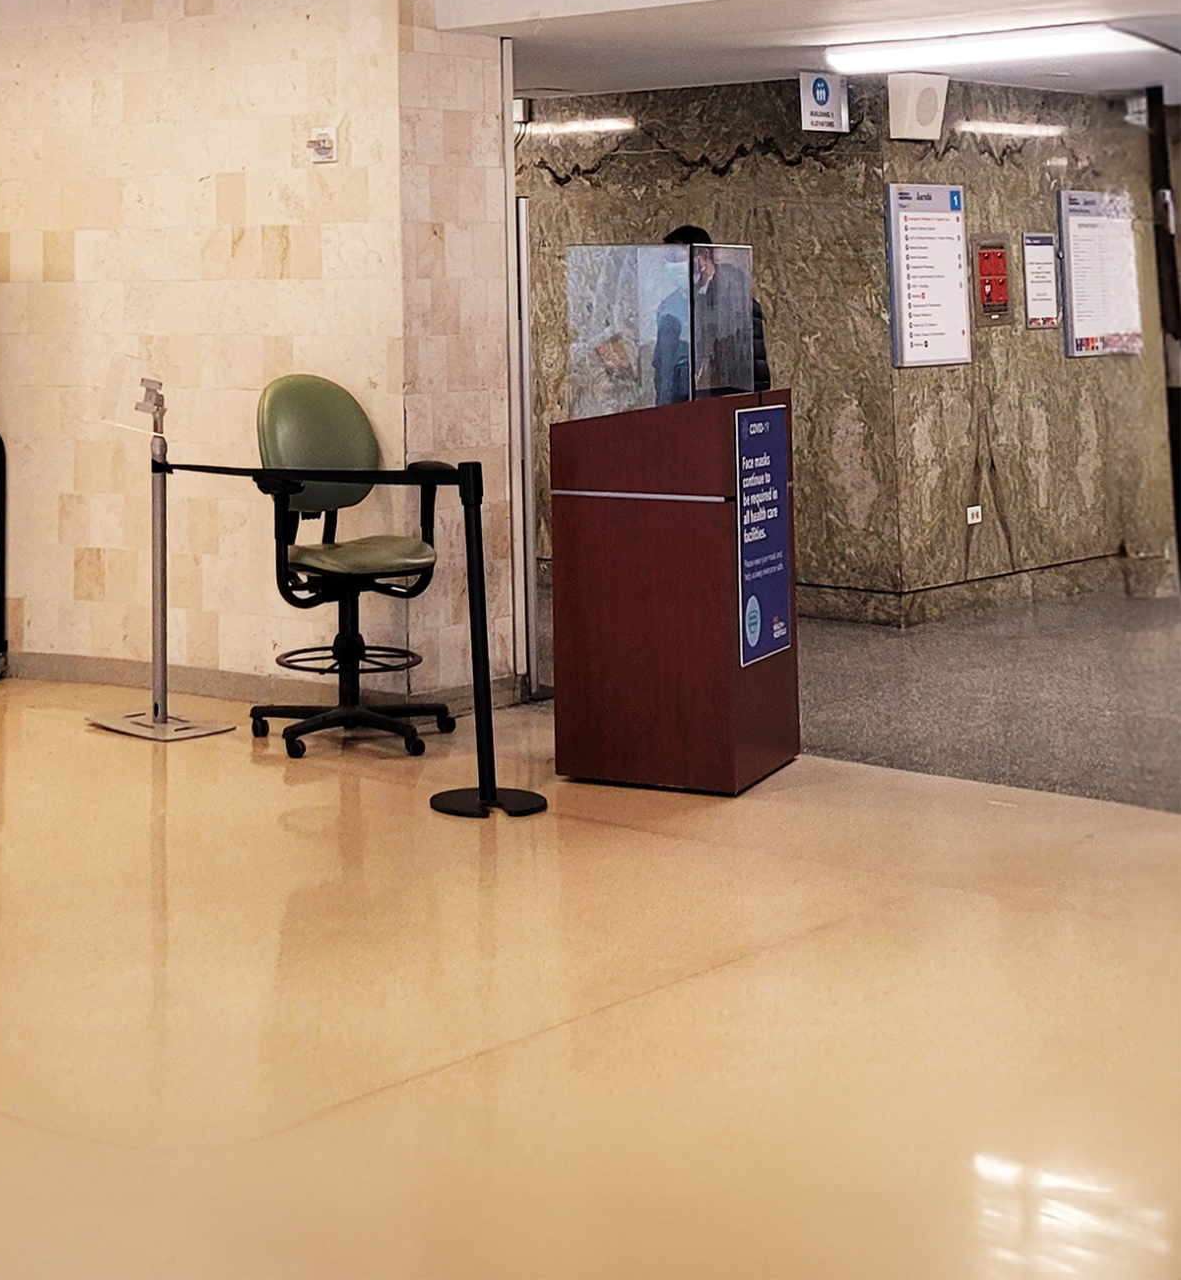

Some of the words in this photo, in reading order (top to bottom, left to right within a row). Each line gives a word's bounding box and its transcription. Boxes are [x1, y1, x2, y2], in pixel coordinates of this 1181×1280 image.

[742, 455, 754, 470] Face
[754, 451, 770, 468] masks
[743, 472, 764, 488] continue
[765, 471, 771, 484] to
[743, 492, 750, 507] be
[751, 486, 772, 508] required
[772, 487, 778, 500] in
[751, 506, 766, 524] health
[767, 507, 778, 520] care
